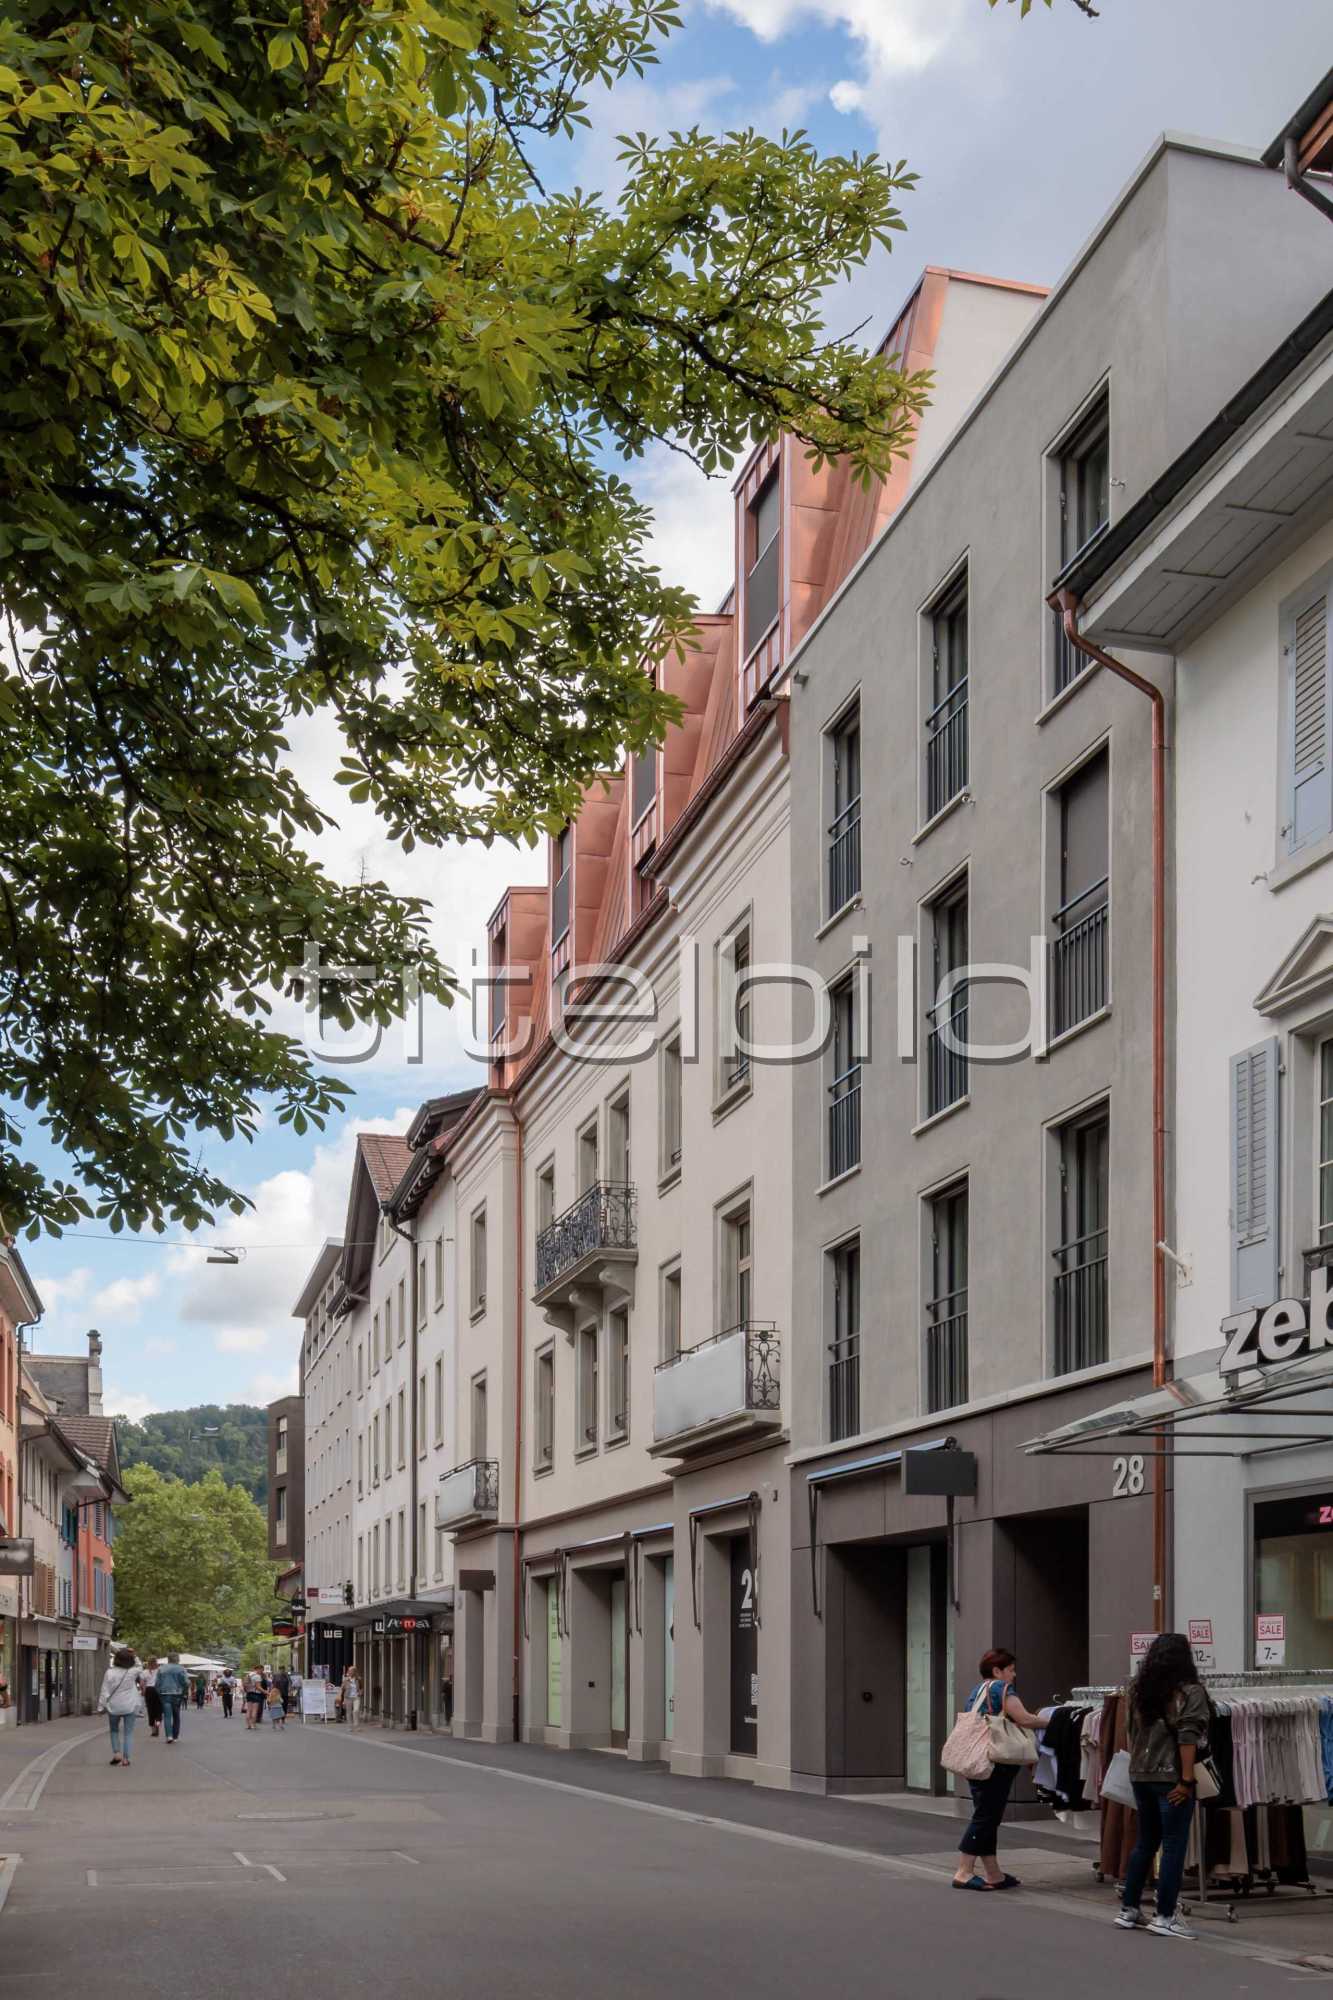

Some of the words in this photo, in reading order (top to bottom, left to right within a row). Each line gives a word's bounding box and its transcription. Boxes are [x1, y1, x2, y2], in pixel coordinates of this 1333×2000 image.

[1113, 1455, 1145, 1496] 28
[323, 1629, 343, 1639] WE
[1191, 1630, 1209, 1639] SALE
[1259, 1624, 1282, 1635] SALE
[1194, 1649, 1211, 1662] 12.-
[1263, 1647, 1278, 1660] 7.-
